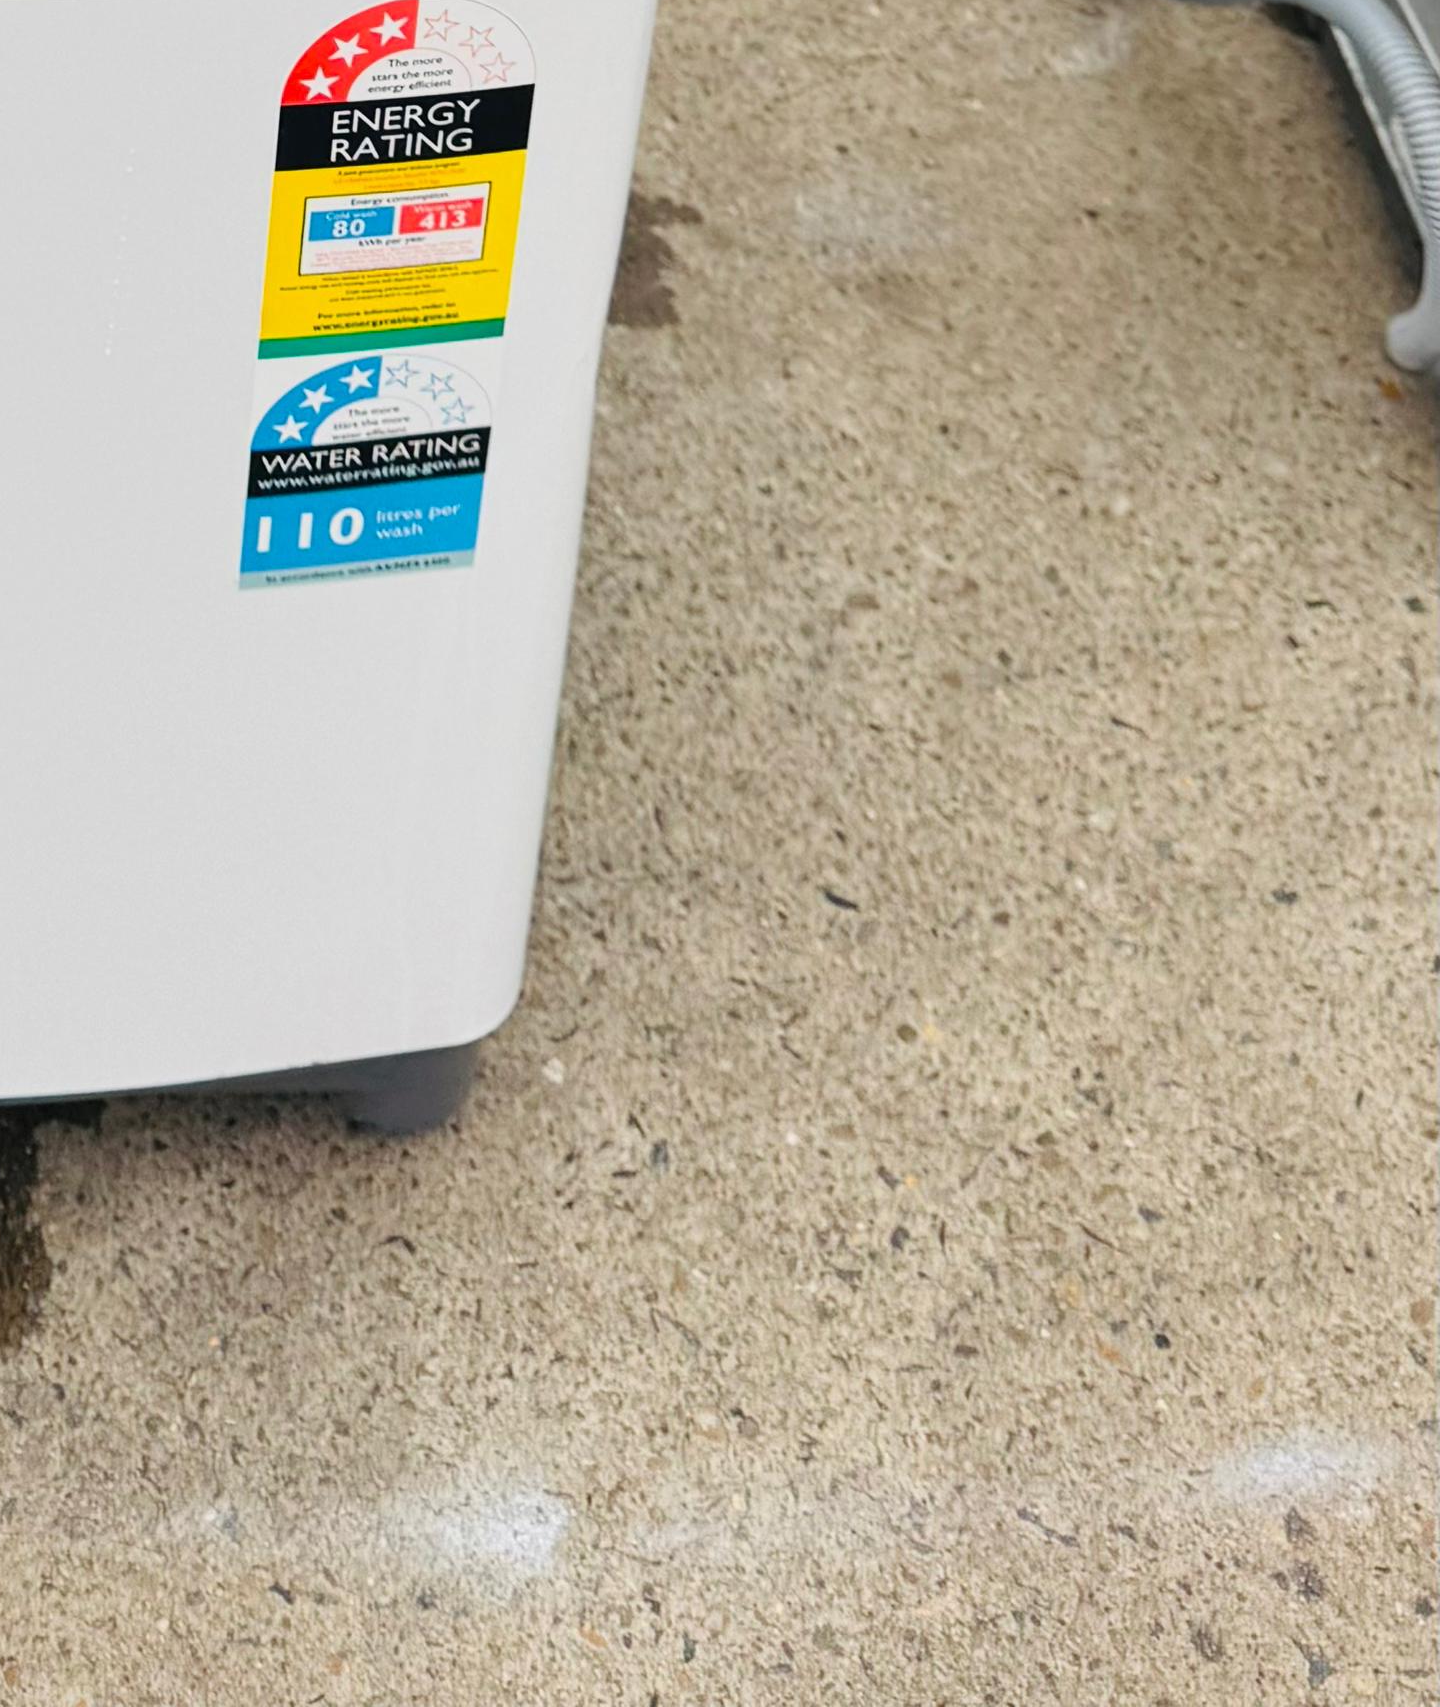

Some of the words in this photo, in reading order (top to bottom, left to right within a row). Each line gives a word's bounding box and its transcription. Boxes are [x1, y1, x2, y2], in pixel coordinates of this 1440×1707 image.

[389, 59, 409, 68] The
[412, 57, 443, 66] more
[372, 73, 398, 82] stars
[402, 71, 420, 80] the
[423, 68, 454, 78] more
[368, 85, 405, 93] energy
[409, 79, 452, 90] efficient
[332, 98, 480, 135] ENERGY
[330, 127, 474, 162] RATING
[332, 219, 366, 238] 80
[419, 210, 467, 230] 413
[262, 446, 363, 475] WATER
[372, 433, 481, 464] RATING
[257, 456, 480, 490] www.waterrating.gov.au
[376, 508, 423, 524] litres
[428, 504, 461, 521] per
[257, 507, 365, 553] 110
[376, 523, 424, 539] wash
